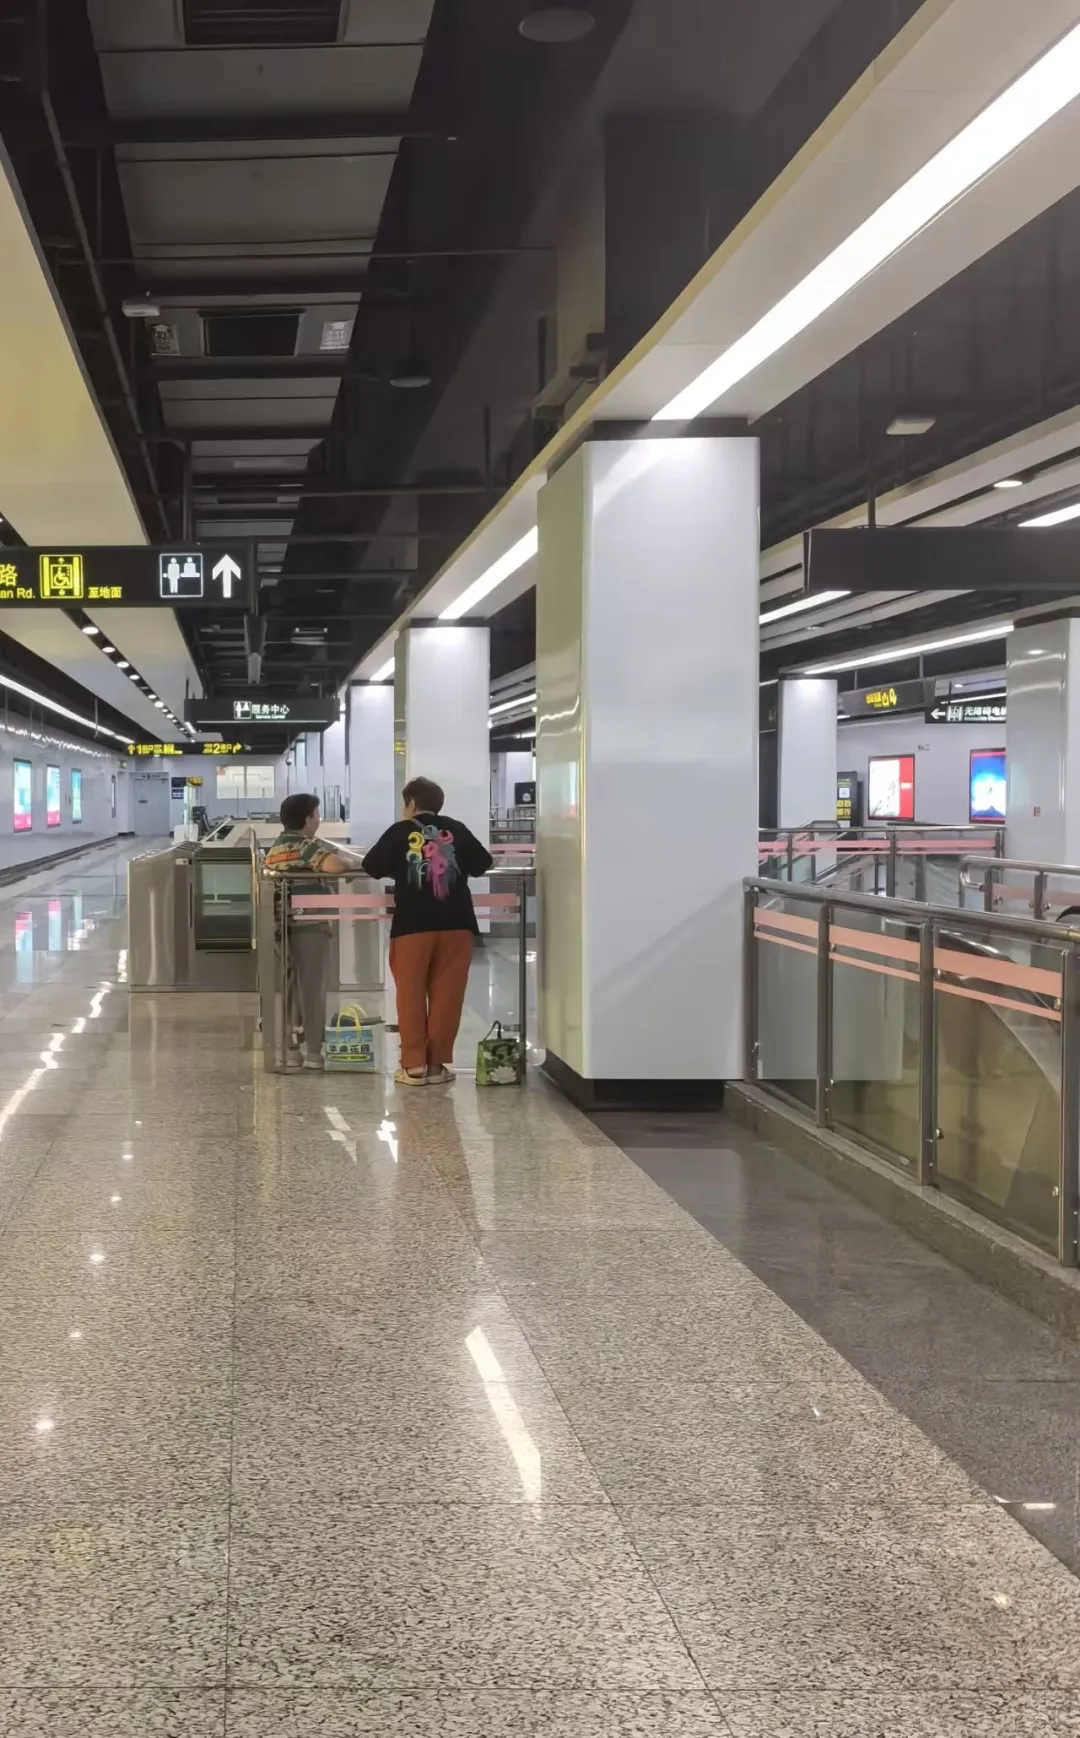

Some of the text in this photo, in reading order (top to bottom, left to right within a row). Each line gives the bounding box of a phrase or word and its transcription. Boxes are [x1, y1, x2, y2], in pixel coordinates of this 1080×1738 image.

[0, 564, 18, 586] 路
[17, 588, 36, 599] Rd.
[88, 586, 122, 598] 至地面
[251, 703, 290, 715] 服务中心
